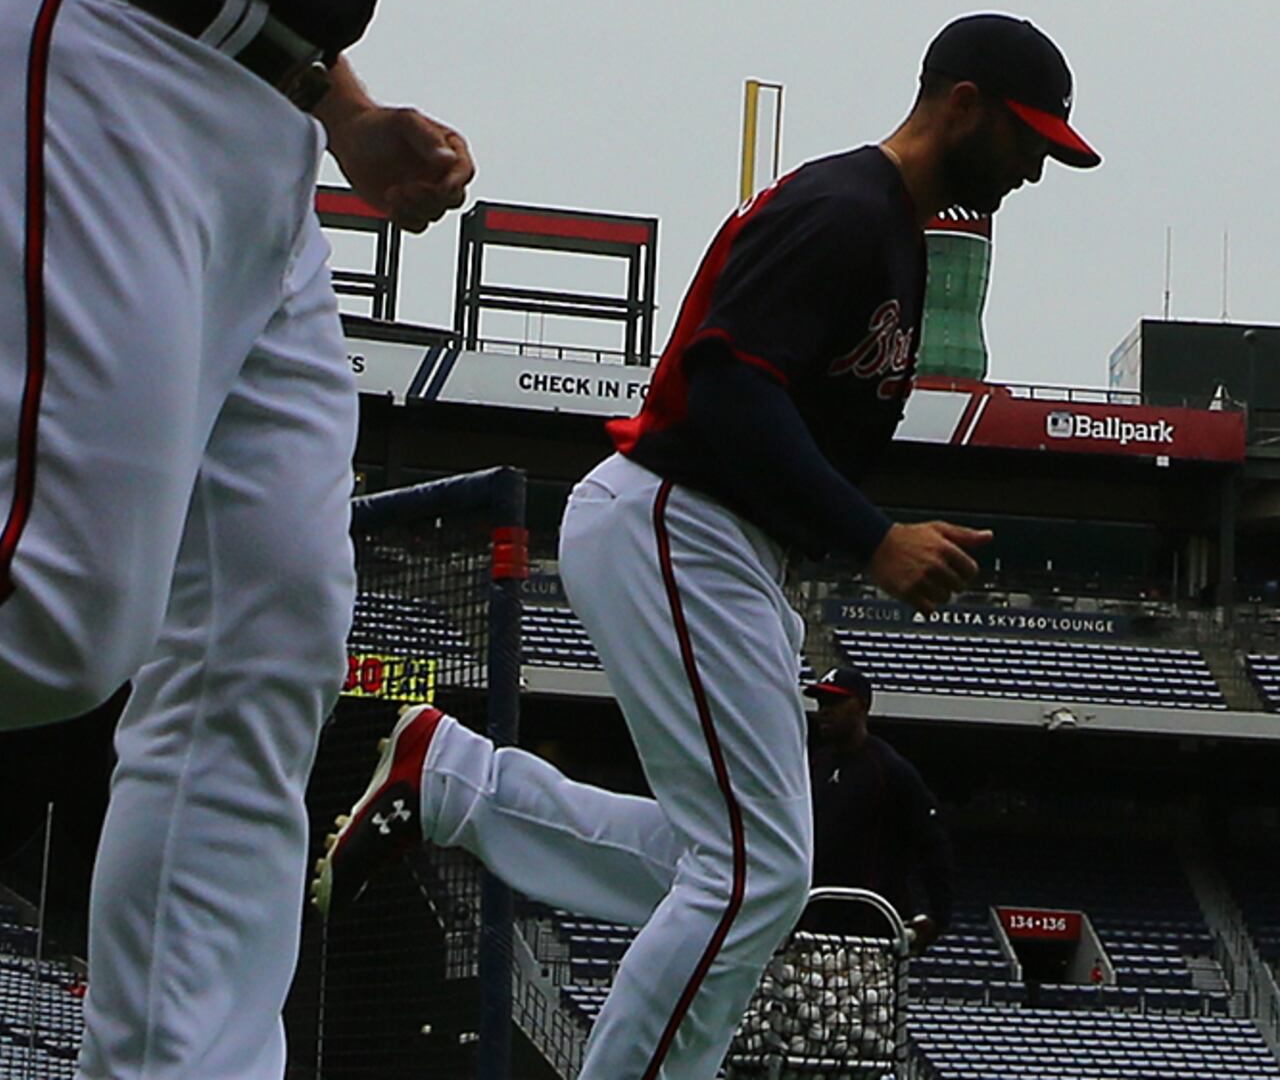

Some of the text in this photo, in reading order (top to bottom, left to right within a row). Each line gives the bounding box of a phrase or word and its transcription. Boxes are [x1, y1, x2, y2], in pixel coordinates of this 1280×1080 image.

[519, 373, 590, 396] CHECK
[597, 380, 620, 399] IN
[1073, 414, 1175, 446] Ballpark
[929, 610, 984, 625] DELTA
[1052, 618, 1115, 634] LOUNGE
